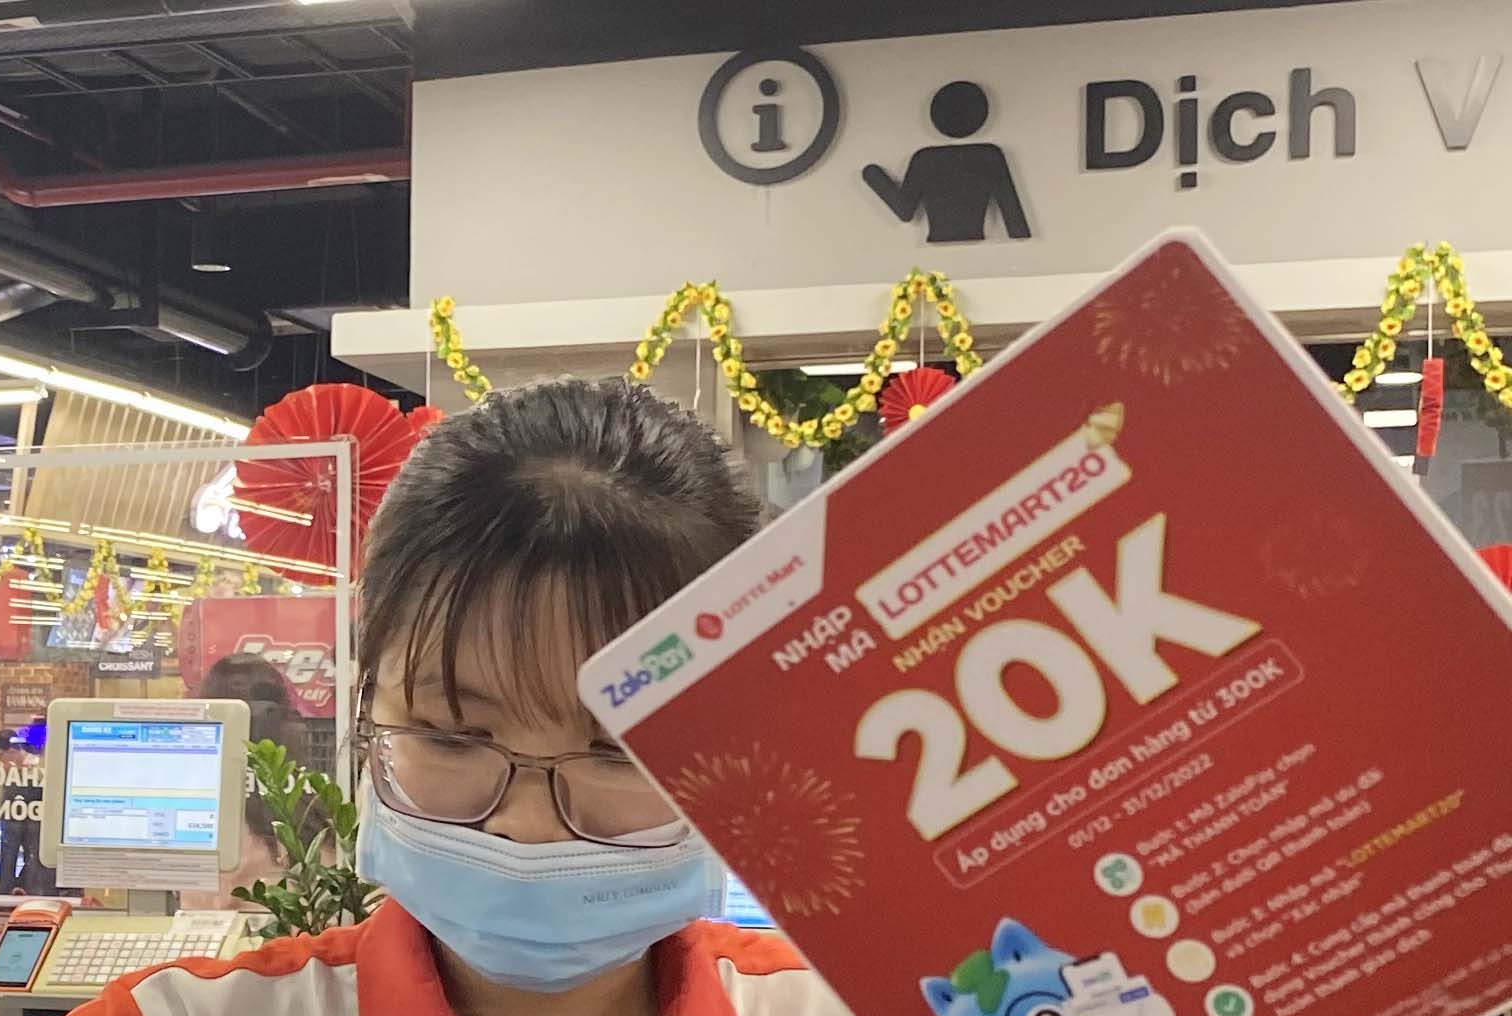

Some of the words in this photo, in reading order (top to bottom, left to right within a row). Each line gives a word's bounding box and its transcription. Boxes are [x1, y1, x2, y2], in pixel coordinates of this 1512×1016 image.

[1085, 67, 1356, 189] Dịch
[878, 451, 1107, 620] LOTTEMART20
[892, 615, 966, 673] NHẬN
[963, 534, 1087, 622] VOUCHER
[98, 661, 155, 672] CROISSANT
[772, 604, 853, 672] NHẬP
[854, 511, 1263, 843] 20K
[954, 844, 990, 874] Áp
[990, 811, 1047, 853] dụng
[1045, 783, 1087, 817] cho
[1087, 755, 1133, 790] đơn
[1129, 718, 1191, 763] hàng
[1216, 656, 1285, 710] 300K
